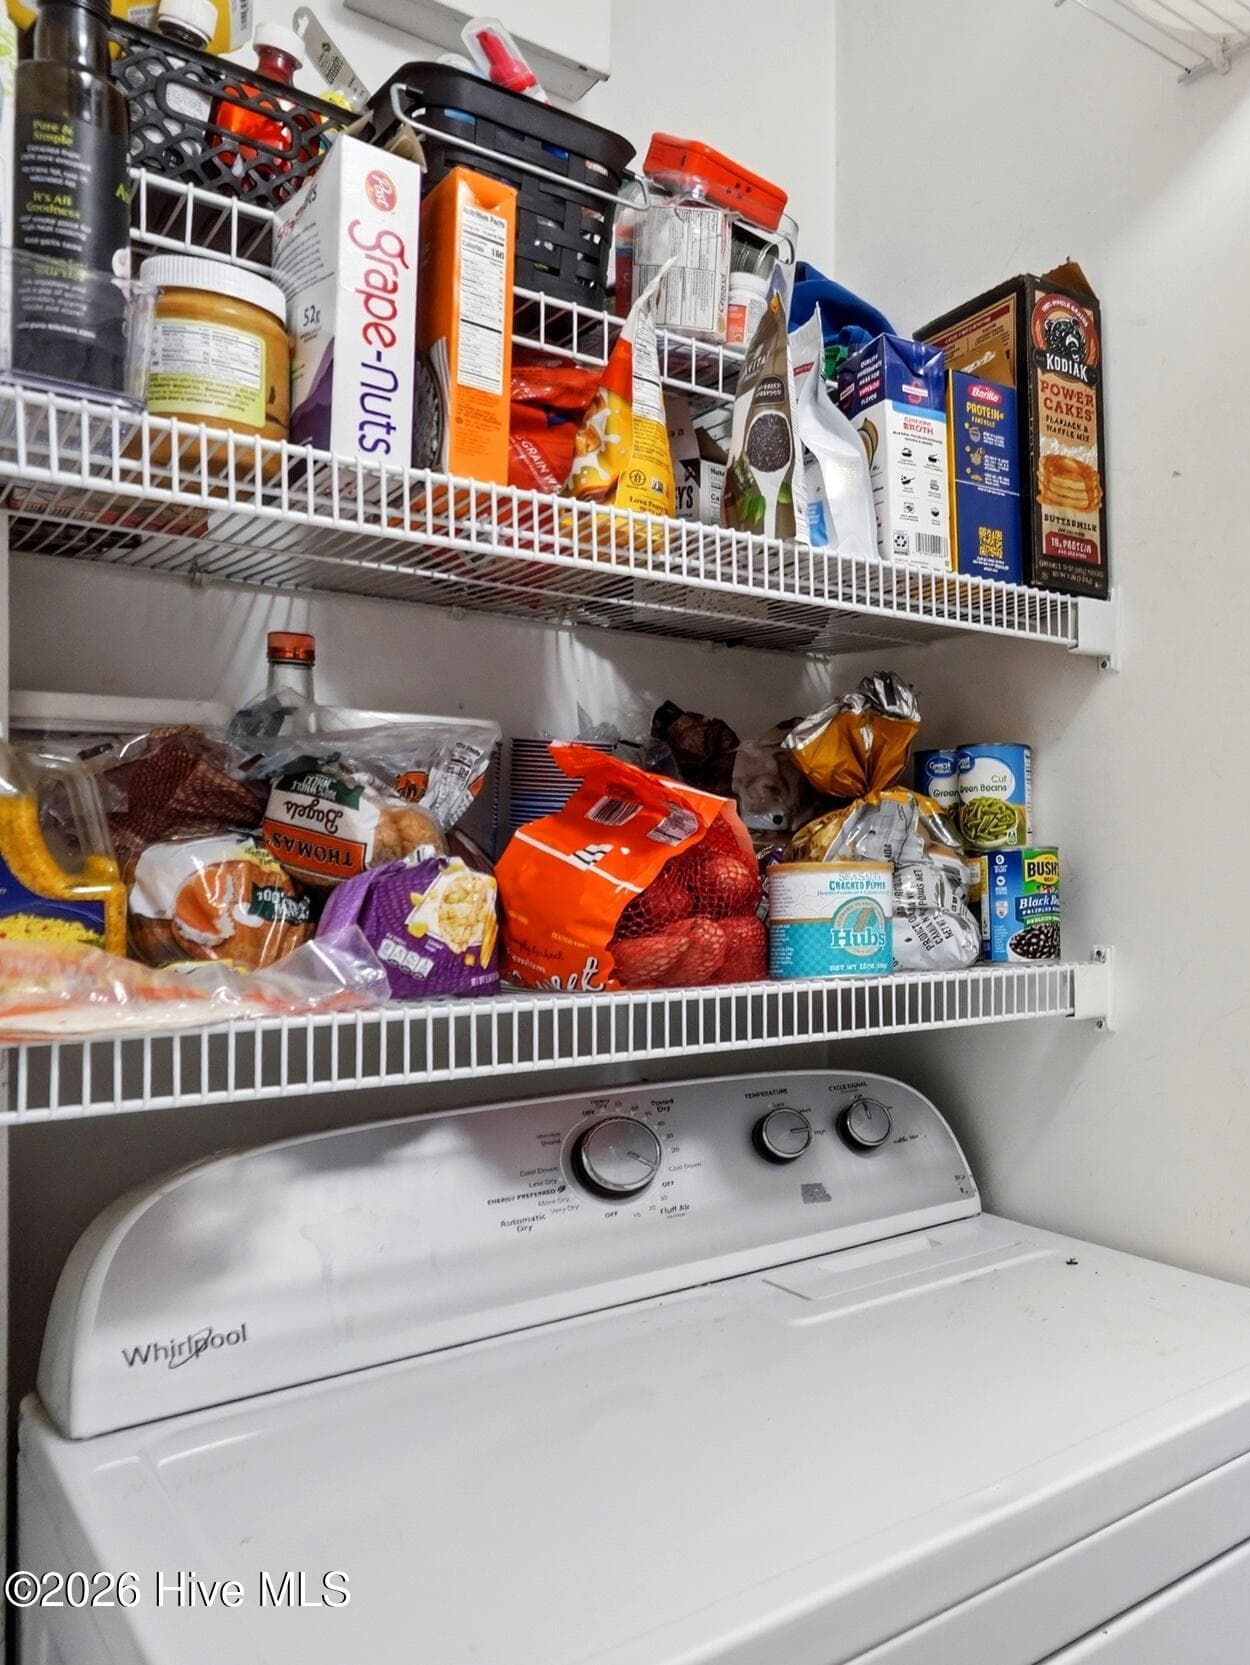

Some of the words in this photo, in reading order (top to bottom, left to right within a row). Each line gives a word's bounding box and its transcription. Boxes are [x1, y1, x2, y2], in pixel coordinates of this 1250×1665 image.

[1046, 353, 1089, 383] KODIAK
[1039, 378, 1094, 407] POWER
[1043, 397, 1093, 423] CAKES
[991, 775, 1007, 783] Cut
[980, 783, 1007, 792] Beans
[283, 797, 344, 835] Bagels
[1020, 894, 1049, 909] Black
[744, 1087, 788, 1100] TEMPERATURE
[671, 1146, 680, 1154] 20
[487, 1196, 516, 1206] ENERGY
[516, 1189, 556, 1201] PREFERRED
[660, 1205, 678, 1215] Fluff
[678, 1203, 690, 1211] Air
[500, 1213, 547, 1227] Automatic
[516, 1224, 533, 1233] Dry
[121, 1322, 247, 1370] Whirlpool
